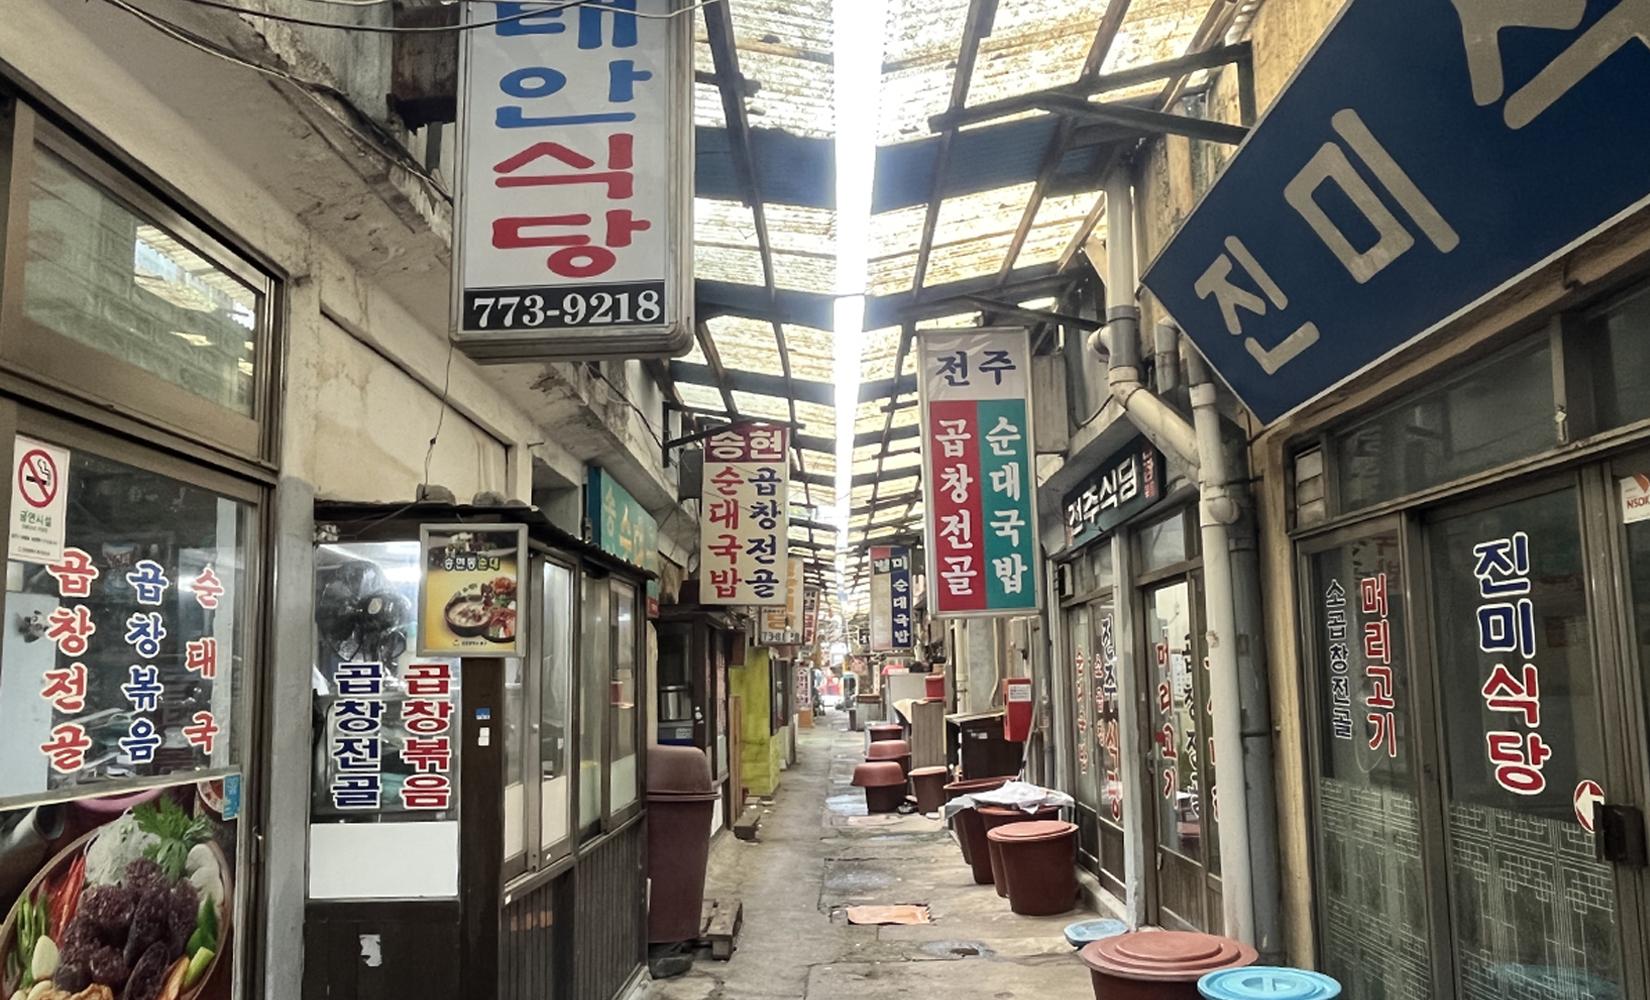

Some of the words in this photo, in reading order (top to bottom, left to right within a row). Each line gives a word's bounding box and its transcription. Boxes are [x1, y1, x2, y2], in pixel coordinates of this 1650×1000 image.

[473, 290, 661, 328] 773-9218
[935, 350, 1017, 387] 전주
[710, 430, 783, 460] 송현
[935, 418, 979, 597] 곱창전골
[985, 415, 1029, 596] 순대국밥
[708, 466, 745, 600] 순대국밥
[745, 466, 783, 599] 곱창전골
[40, 547, 100, 775] 곱창전골
[119, 559, 169, 765] 곱창볶음
[182, 562, 225, 756] 순대국
[331, 661, 387, 810] 곱창전골
[399, 661, 454, 810] 곱창볶음
[1156, 640, 1179, 811] 머리고기
[1325, 577, 1353, 740] 소곱창전골
[1360, 572, 1398, 758] 머리고기
[1473, 531, 1552, 796] 진미식당
